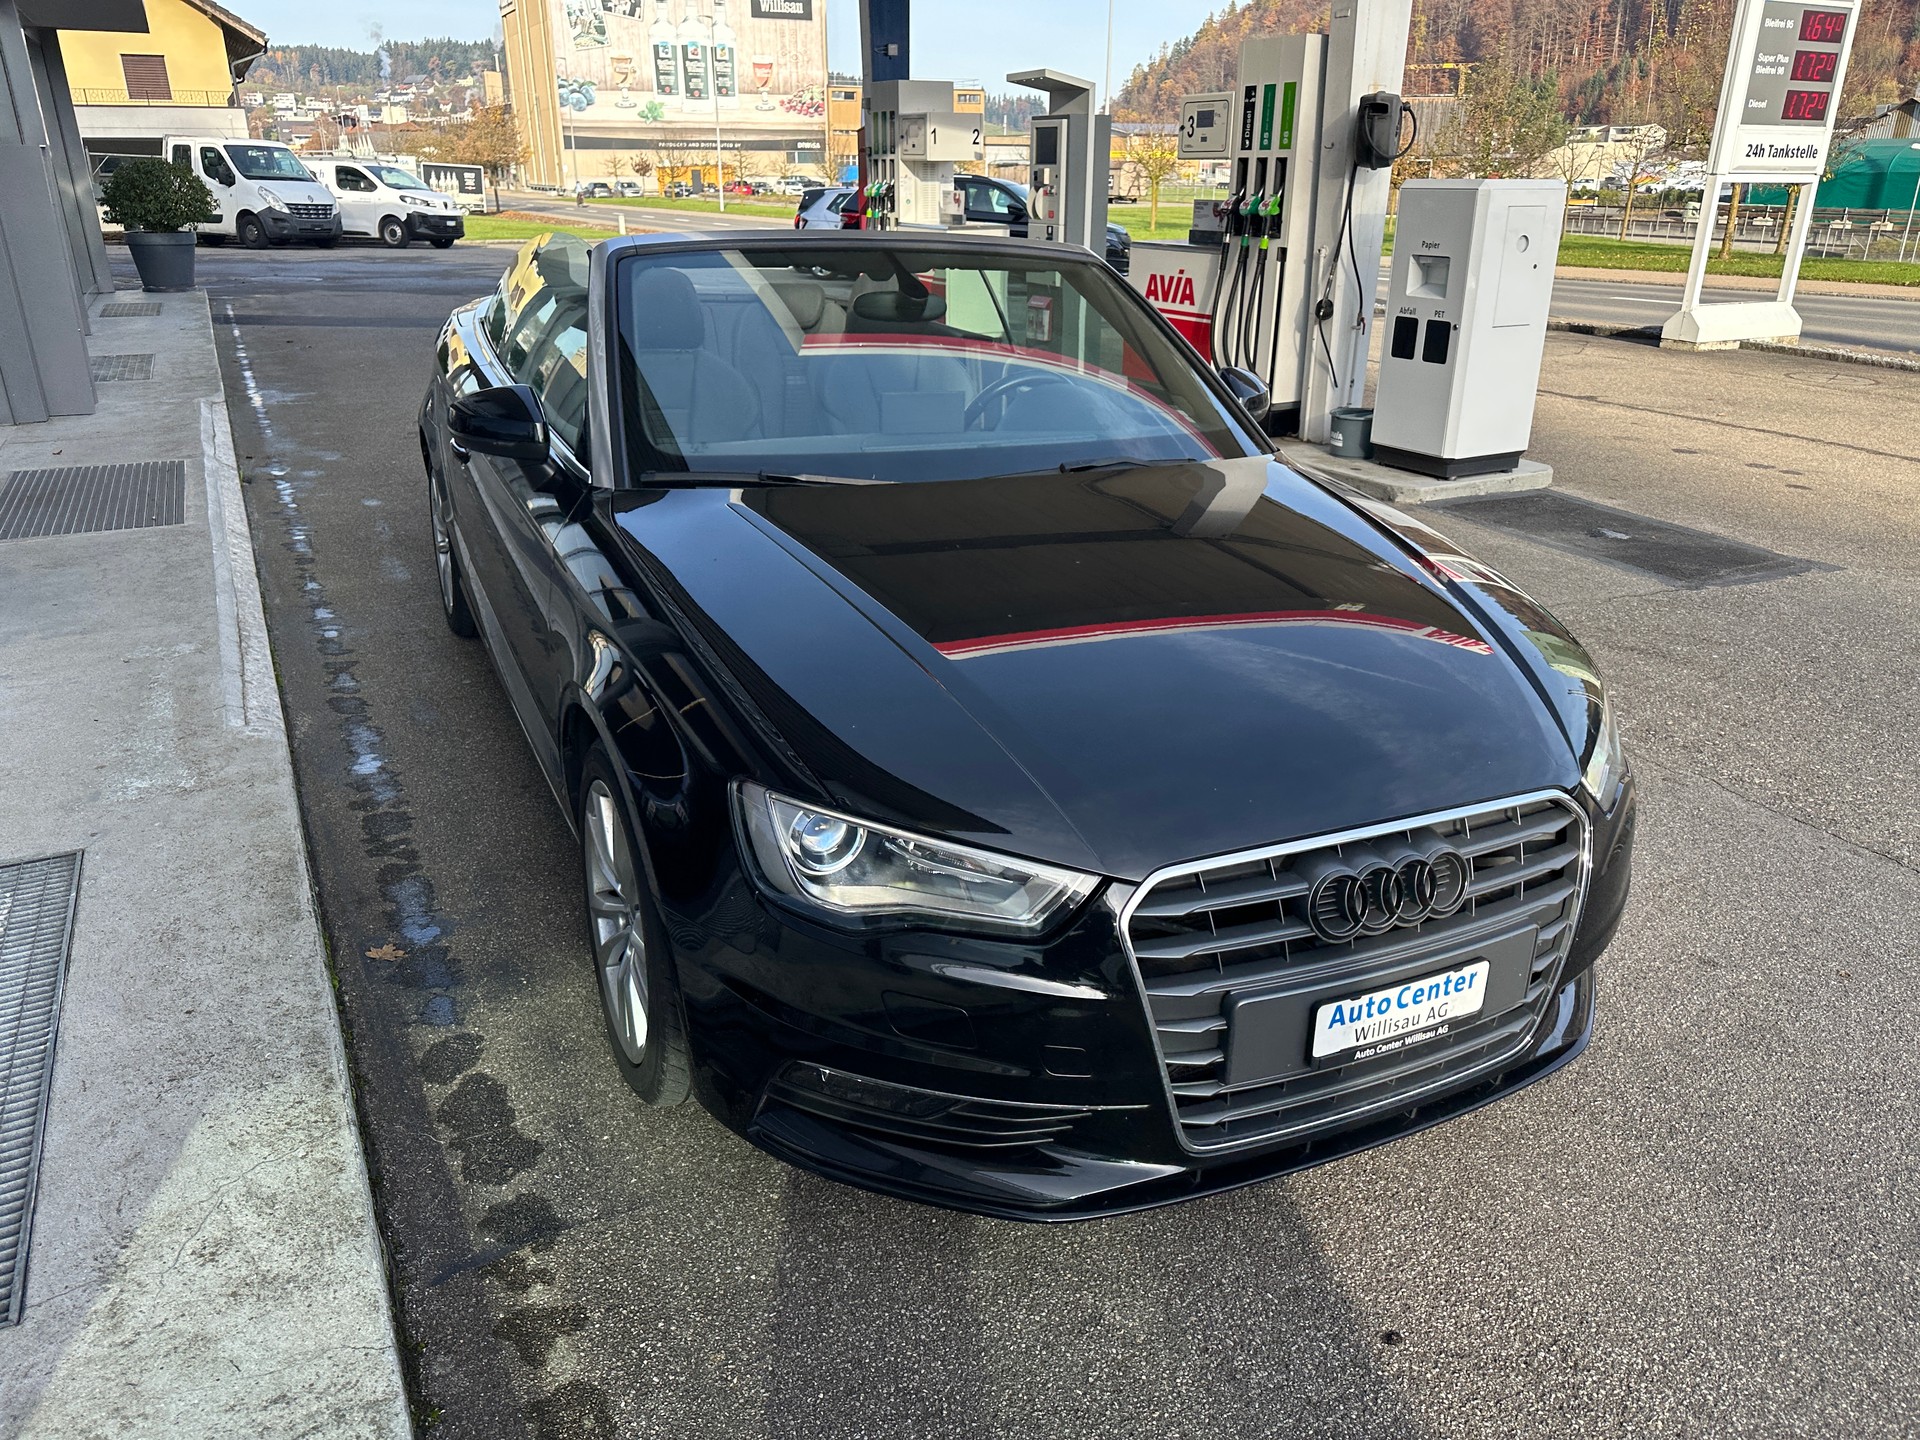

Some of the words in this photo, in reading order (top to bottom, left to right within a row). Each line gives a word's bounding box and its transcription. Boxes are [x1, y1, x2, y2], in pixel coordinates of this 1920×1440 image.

[1765, 18, 1787, 29] Bleifrei
[1787, 20, 1795, 29] 95
[1757, 53, 1776, 63] Super
[1777, 54, 1789, 63] Plus
[1755, 65, 1776, 75] Bleifrei
[1748, 99, 1767, 108] Diesel
[1187, 115, 1195, 138] 3
[931, 127, 937, 144] 1
[972, 128, 980, 145] 2
[1746, 144, 1765, 158] 24h
[1768, 144, 1818, 159] Tankstelle
[1421, 240, 1441, 250] Papier
[1399, 306, 1416, 316] Abfall
[1434, 310, 1445, 318] PET
[1328, 996, 1391, 1029] Auto
[1396, 971, 1478, 1009] Center
[1354, 1013, 1420, 1043] Willisau
[1425, 1002, 1449, 1022] AG
[1354, 1049, 1375, 1060] Auto
[1376, 1039, 1403, 1055] Center
[1405, 1029, 1436, 1046] Willisau
[1436, 1024, 1449, 1035] AG
